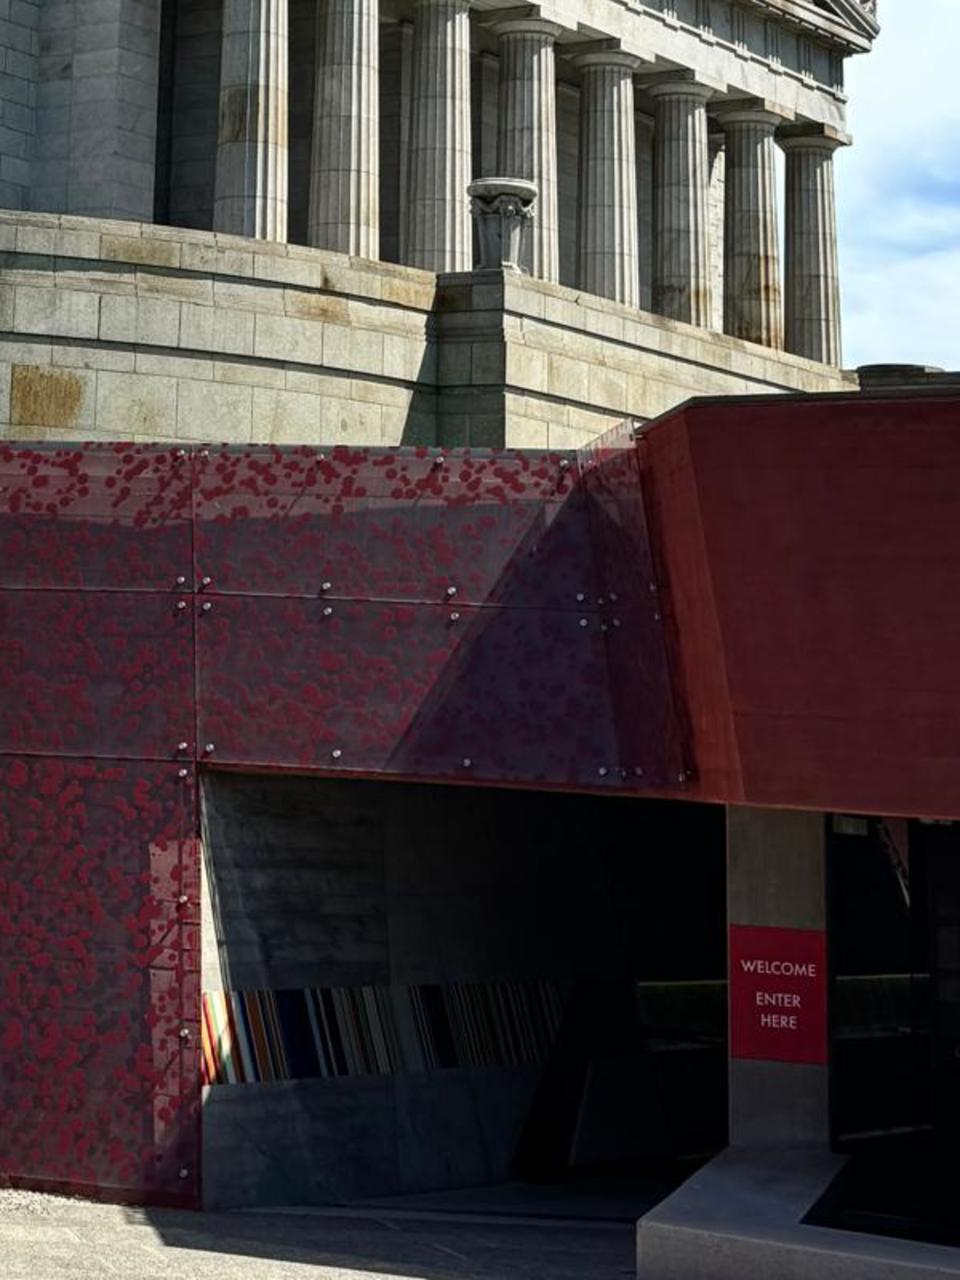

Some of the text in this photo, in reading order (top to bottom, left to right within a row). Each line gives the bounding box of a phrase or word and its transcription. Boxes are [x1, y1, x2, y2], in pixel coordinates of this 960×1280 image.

[741, 959, 817, 977] WELCOME
[756, 991, 801, 1008] ENTER
[761, 1014, 798, 1029] HERE
